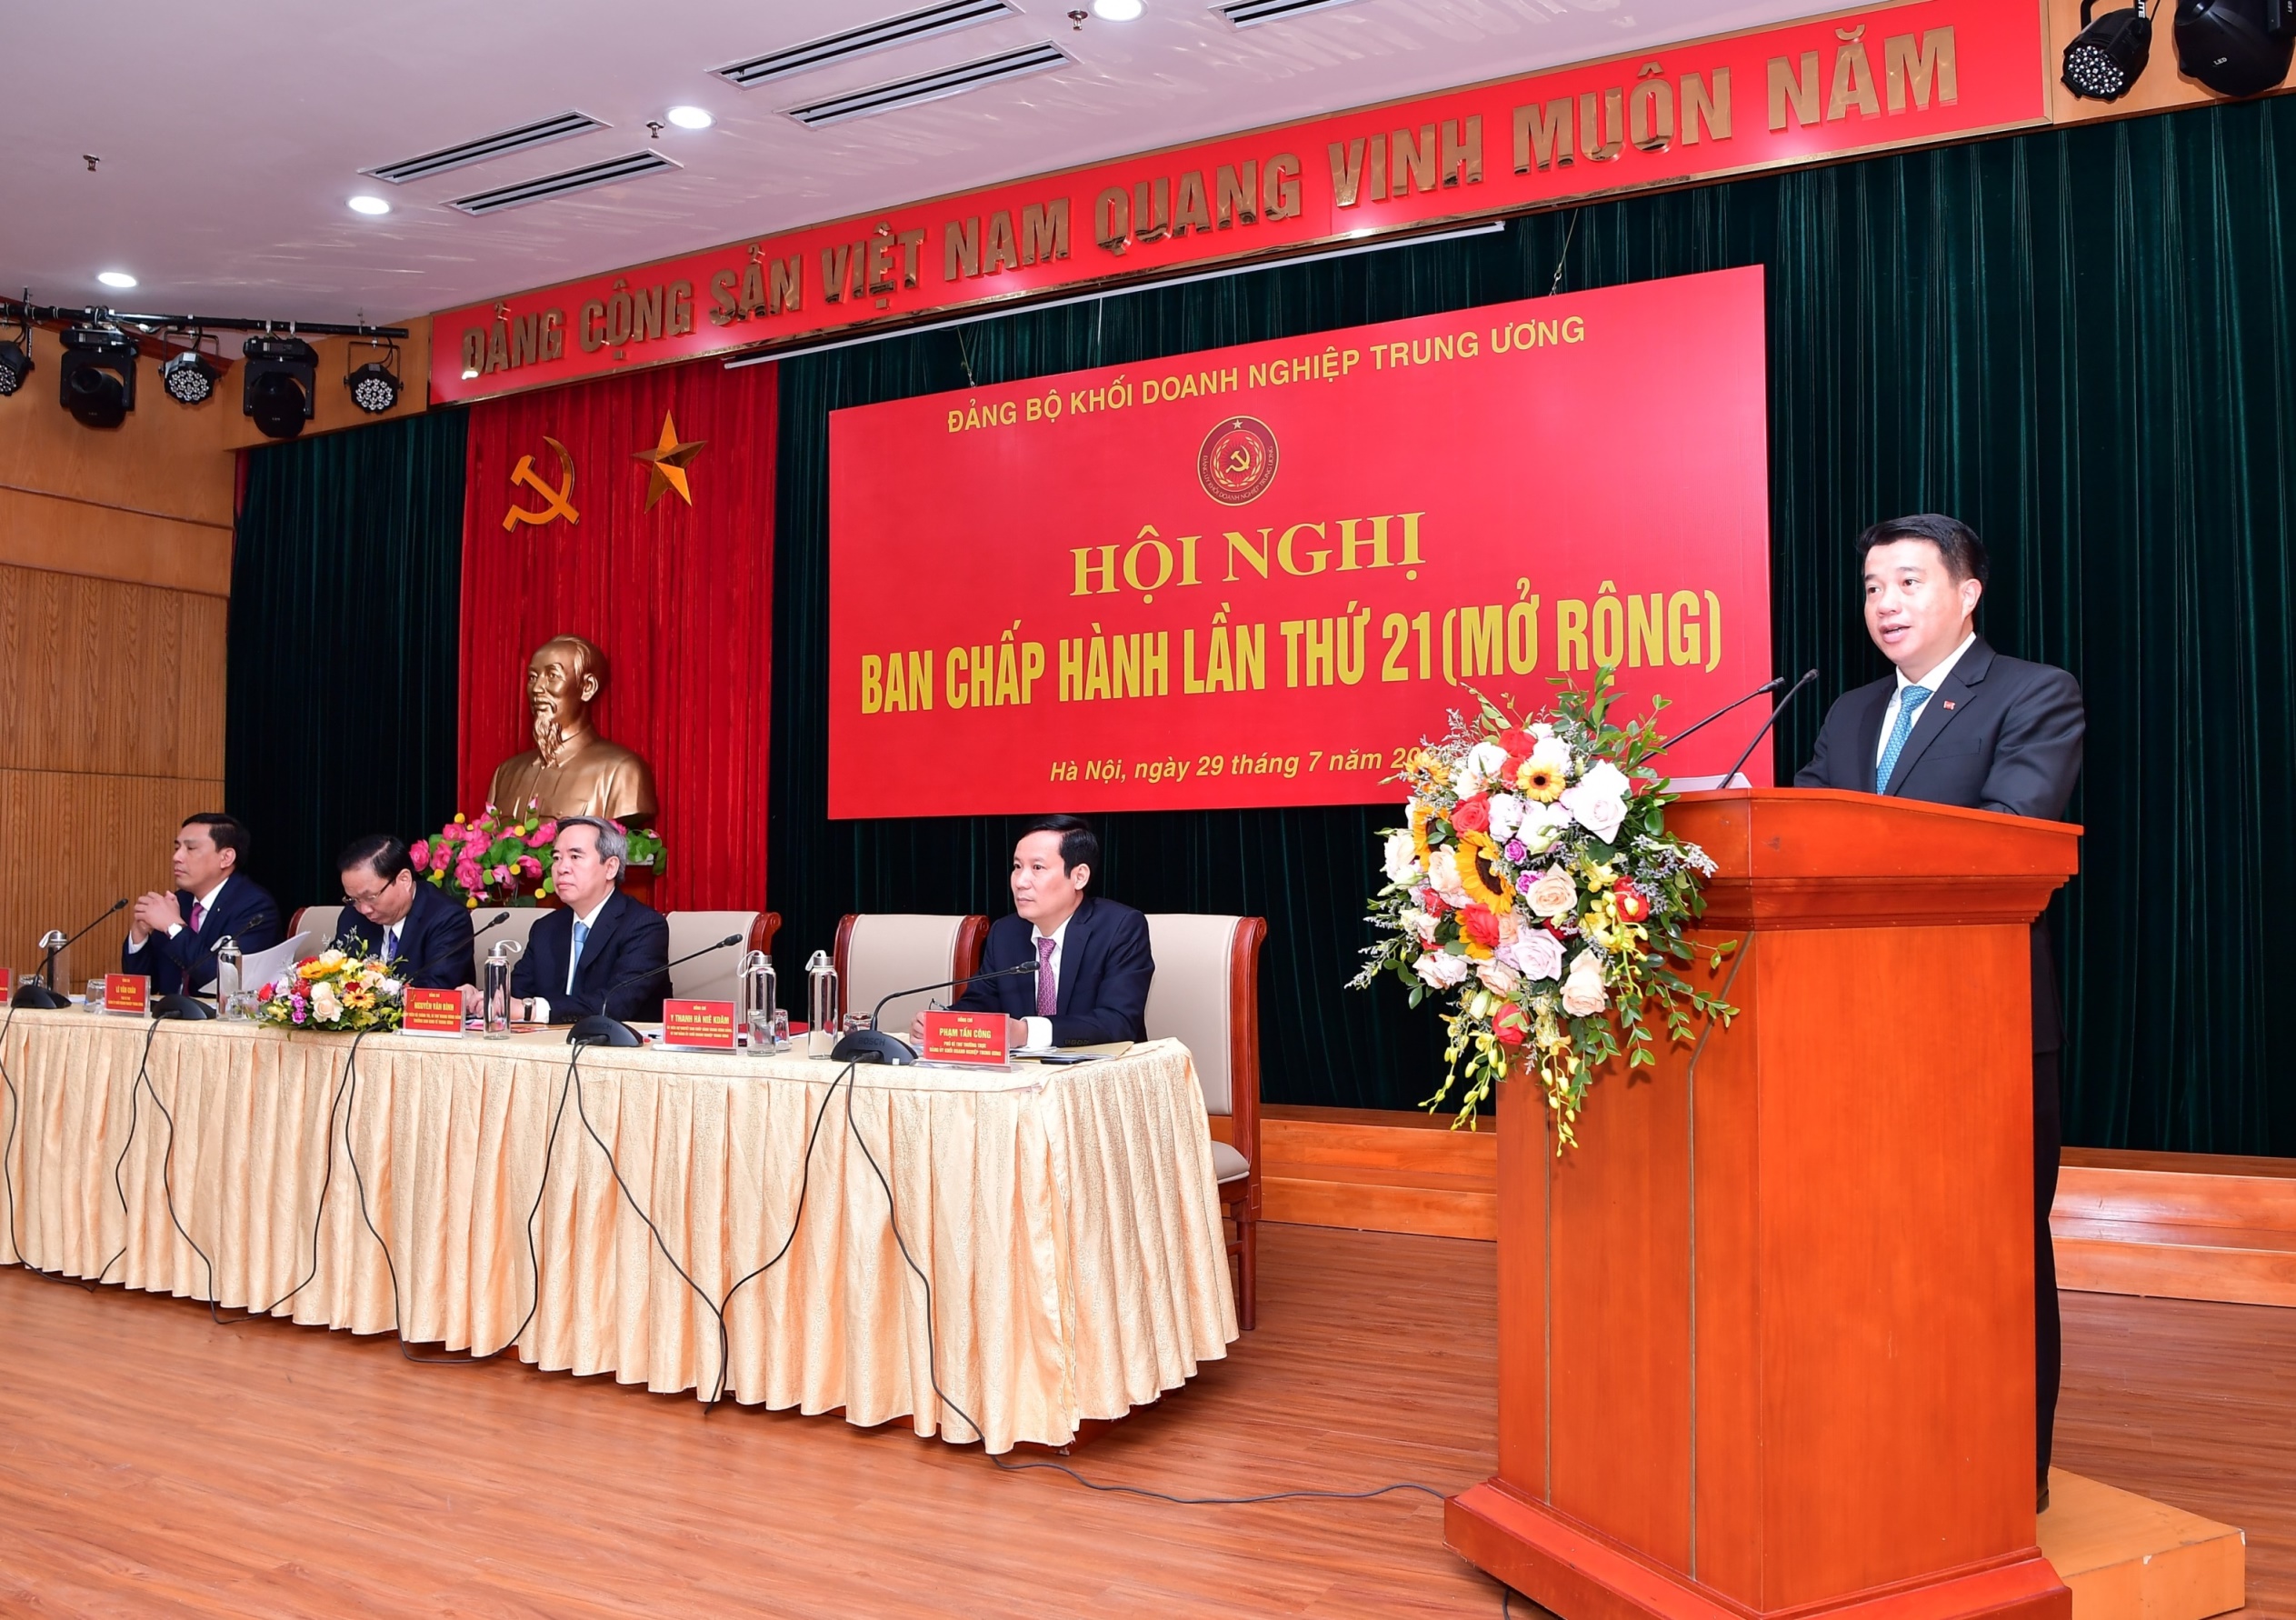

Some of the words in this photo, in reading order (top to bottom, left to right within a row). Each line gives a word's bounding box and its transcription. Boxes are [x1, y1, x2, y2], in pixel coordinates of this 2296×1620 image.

[2213, 56, 2228, 65] LED
[462, 302, 565, 379] ĐẢNG
[579, 278, 695, 360] CỘNG
[709, 243, 804, 325] SẢN
[821, 222, 926, 309] VIỆT
[944, 197, 1071, 282] NAM
[1094, 153, 1303, 256] QUANG
[1328, 115, 1484, 208] VINH
[1512, 61, 1732, 175] MUÔN
[1767, 24, 1958, 133] NĂM
[947, 398, 1017, 433] ĐẢNG
[1026, 388, 1063, 424] BỘ
[1071, 374, 1133, 415] KHỐI
[1142, 367, 1238, 405] DOANH
[1248, 345, 1361, 388] NGHIỆP
[1370, 331, 1479, 370] TRUNG
[1491, 315, 1585, 353] ƯƠNG
[1218, 492, 1240, 501] DOANH
[1069, 524, 1203, 605] HỘI
[1222, 511, 1426, 581] NGHỊ
[861, 649, 933, 715] BAN
[945, 619, 1046, 709] CHẤP
[1059, 622, 1169, 703] HÀNH
[1183, 602, 1266, 695] LẦN
[1280, 600, 1372, 688] THỨ
[1556, 580, 1722, 686] RỘNG)
[1049, 760, 1079, 782] Hà
[1084, 758, 1127, 785] Nội,
[1133, 759, 1190, 784] ngày
[1195, 754, 1224, 777] 29
[1231, 751, 1300, 778] tháng
[1308, 751, 1323, 773] 7
[1328, 747, 1383, 771] năm
[1390, 746, 1438, 769] 20
[675, 1015, 693, 1023] THANH
[694, 1014, 702, 1023] HÀ
[939, 1027, 958, 1038] PHẠM
[959, 1026, 973, 1037] TẤN
[973, 1028, 992, 1039] CÔNG
